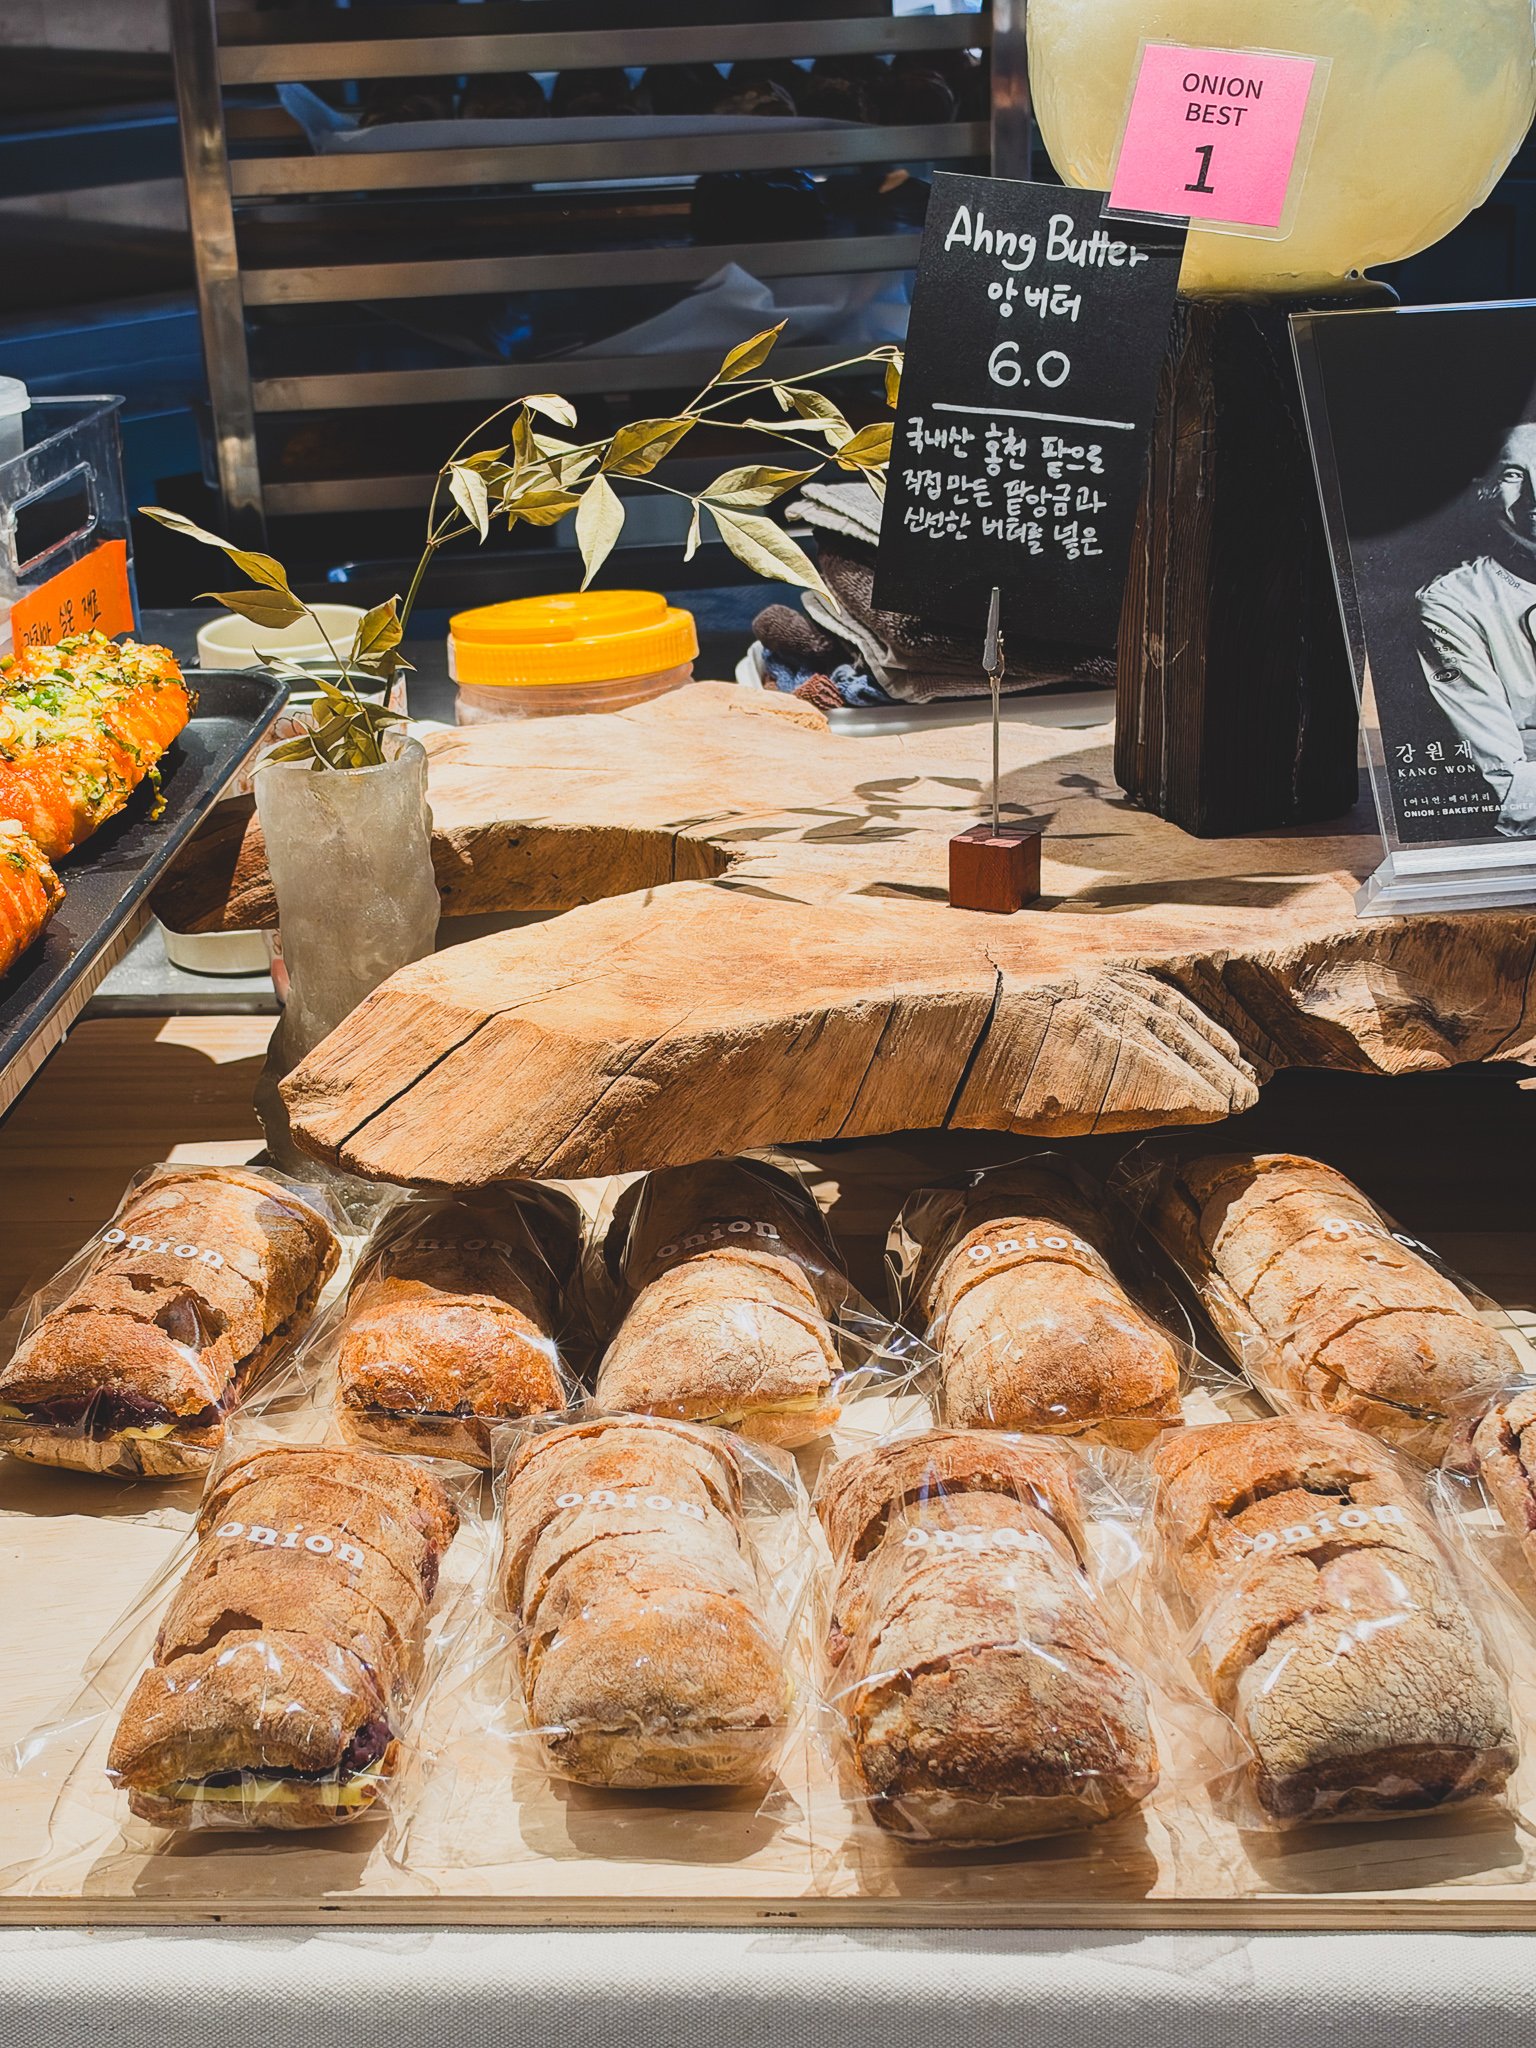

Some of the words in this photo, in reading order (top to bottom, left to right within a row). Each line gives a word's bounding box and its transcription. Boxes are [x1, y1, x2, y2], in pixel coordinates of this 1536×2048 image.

[1182, 73, 1264, 99] ONION
[1185, 102, 1248, 126] BEST
[1184, 145, 1215, 194] 1
[944, 205, 1037, 272] Ahng
[1046, 214, 1149, 268] Butter
[988, 340, 1071, 388] 6.0
[906, 417, 976, 458] 국내산
[984, 422, 1027, 476] 홍천
[903, 506, 971, 540] 신선한
[982, 516, 1044, 555] 버터를
[1397, 766, 1438, 778] KANG
[1444, 764, 1477, 774] WON
[1404, 809, 1435, 818] ONION
[1442, 805, 1479, 816] BAKERY
[1481, 803, 1507, 813] HEAD
[102, 1228, 225, 1269] onion
[656, 1220, 780, 1258] onion
[967, 1230, 1094, 1260] onion
[555, 1486, 706, 1522] onion
[215, 1521, 365, 1570] onion
[1253, 1504, 1408, 1553] onion
